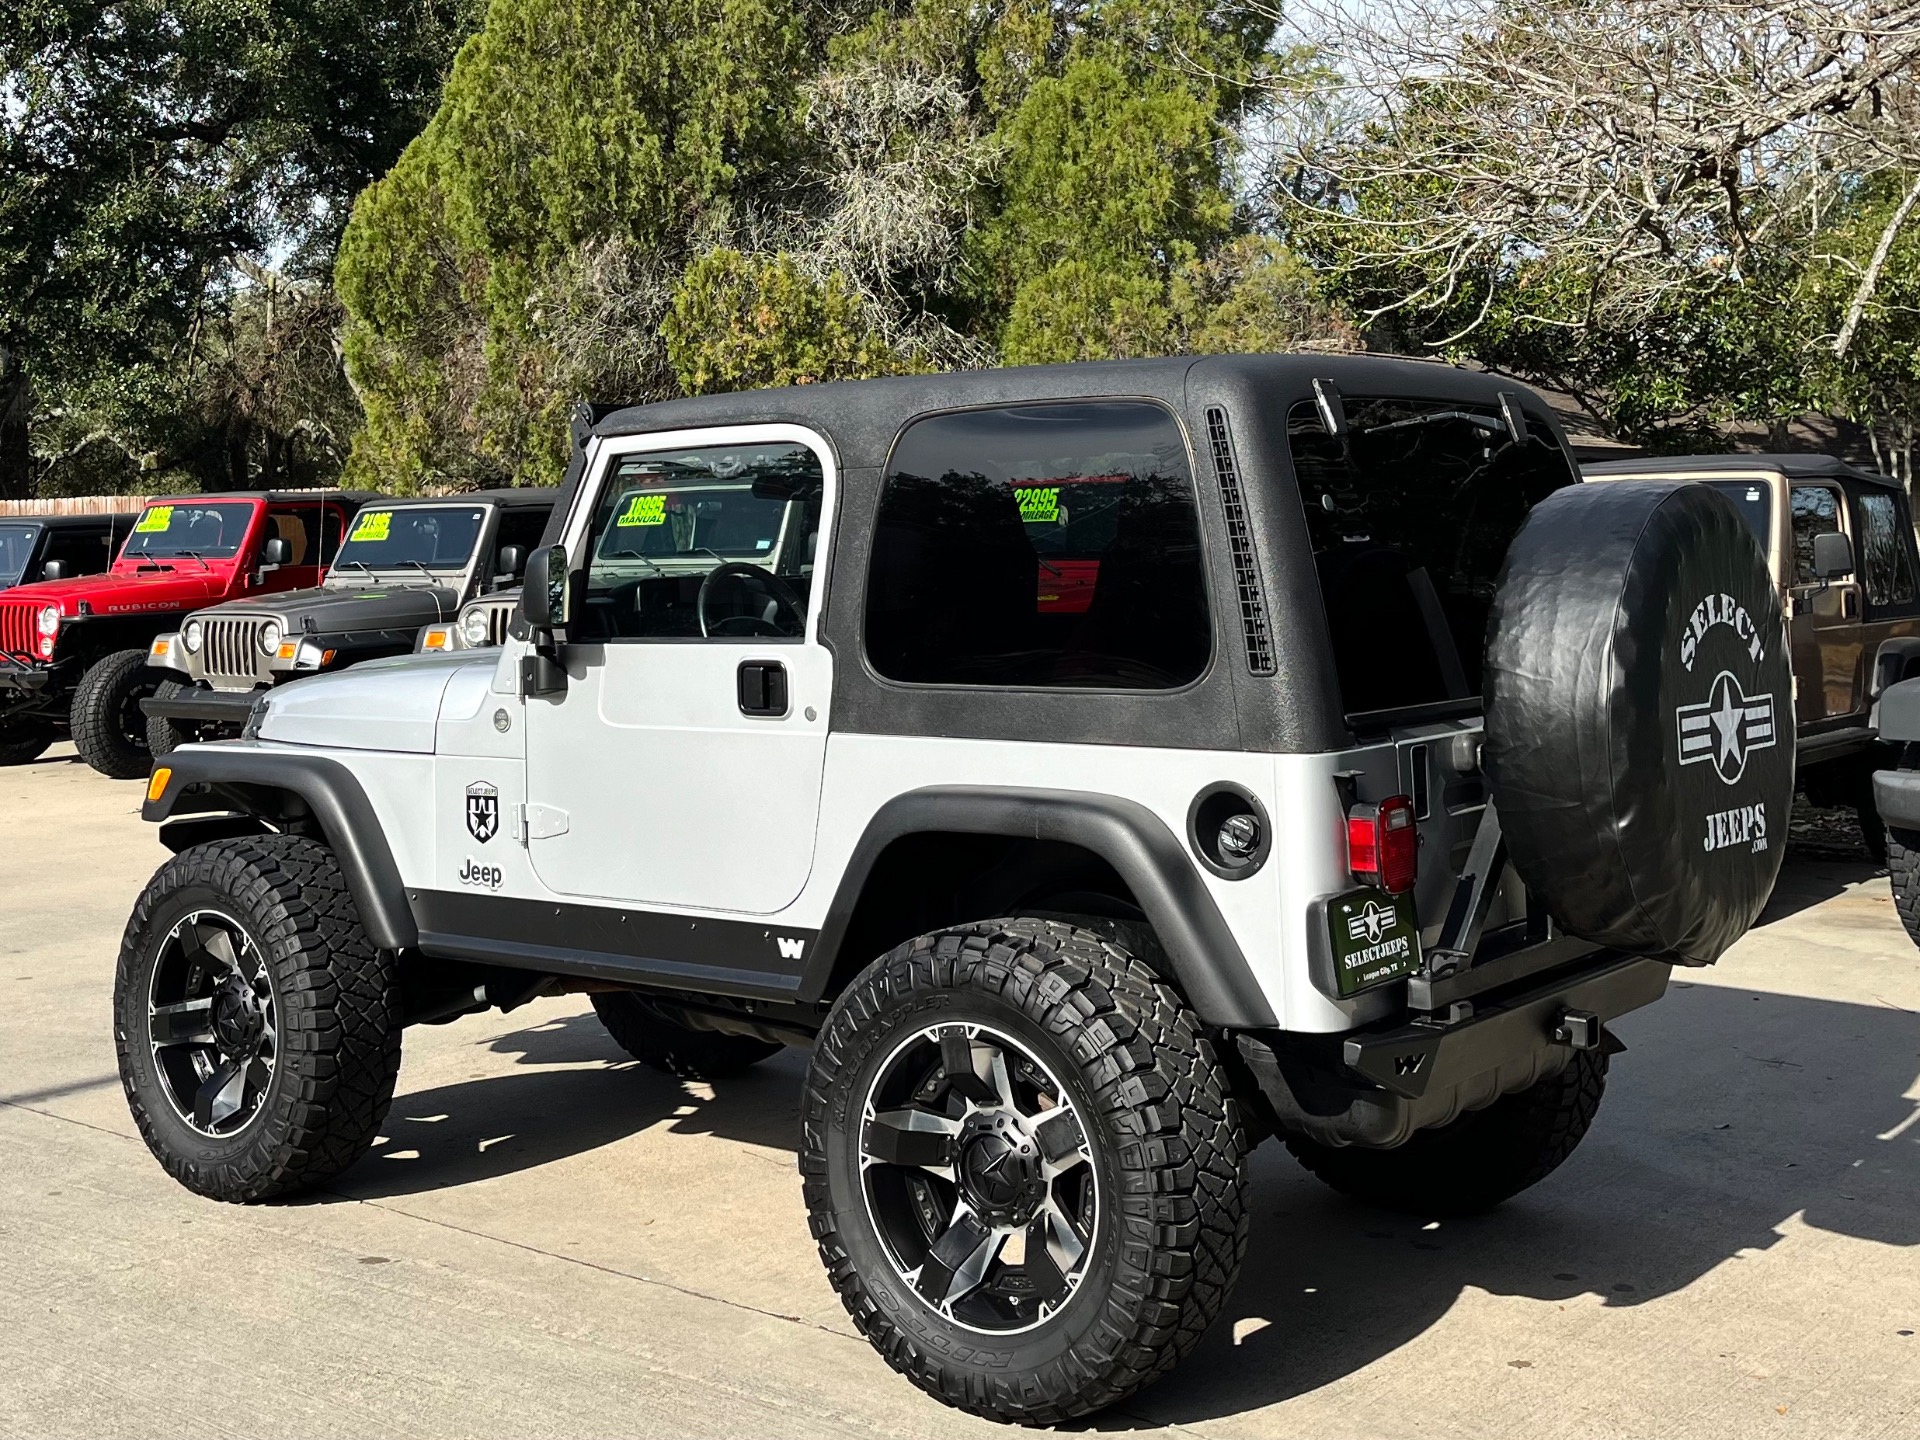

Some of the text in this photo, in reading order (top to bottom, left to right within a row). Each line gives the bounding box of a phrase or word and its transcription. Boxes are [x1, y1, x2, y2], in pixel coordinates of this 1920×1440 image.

[631, 495, 667, 516] 18995
[1014, 487, 1060, 511] 22995
[618, 514, 663, 525] MANUAL
[108, 601, 180, 612] RUBICON
[1680, 592, 1765, 673] SELECT
[1703, 801, 1767, 852] JEEPS
[1751, 837, 1768, 854] .COM
[460, 859, 502, 887] Jeep
[1344, 936, 1408, 970] SELECTJEEPS
[868, 1278, 1016, 1368] NITTO
